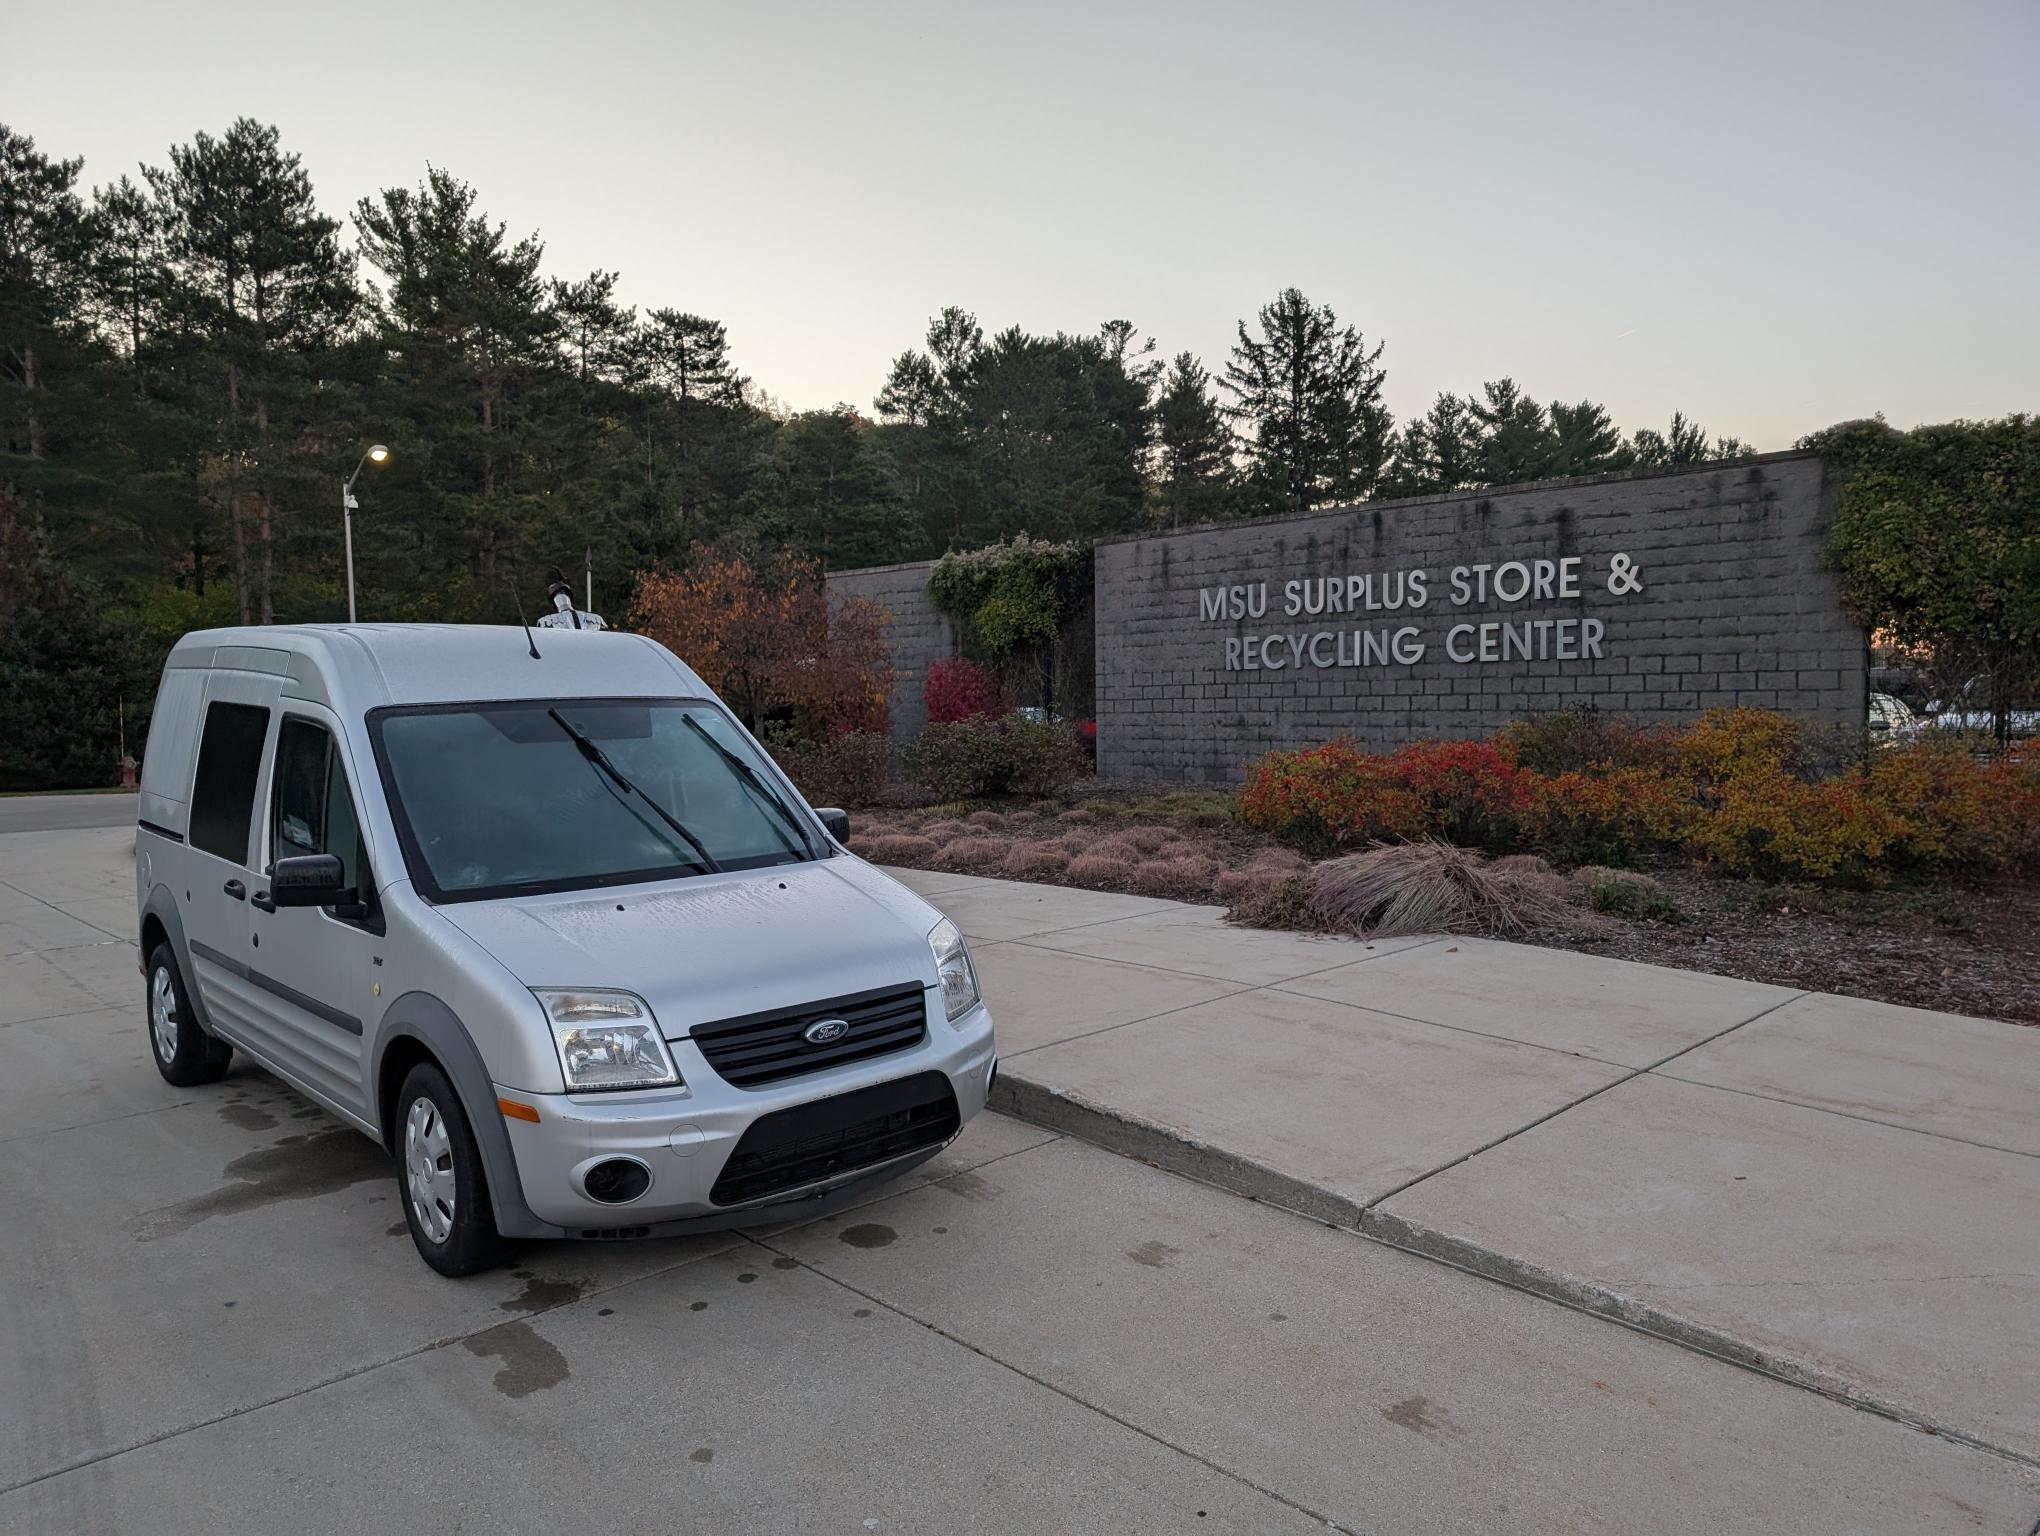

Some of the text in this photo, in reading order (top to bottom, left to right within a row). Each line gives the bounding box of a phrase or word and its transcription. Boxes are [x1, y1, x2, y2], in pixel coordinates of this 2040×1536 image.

[1199, 552, 1644, 622] MSU SURPLUS STORE &
[1225, 618, 1605, 671] RECYCLING CENTER
